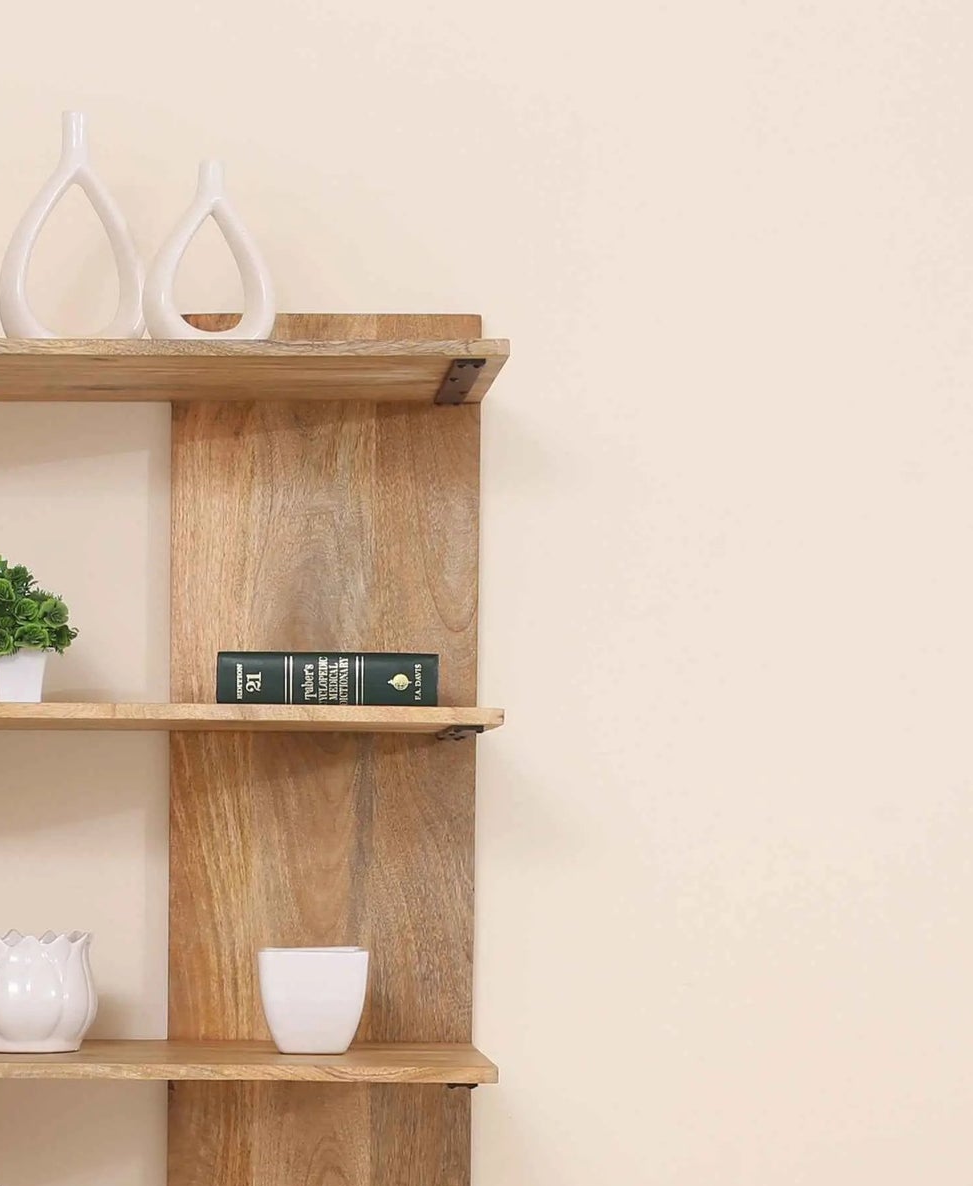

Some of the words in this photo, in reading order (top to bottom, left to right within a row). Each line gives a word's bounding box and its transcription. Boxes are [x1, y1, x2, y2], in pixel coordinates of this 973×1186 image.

[245, 671, 262, 693] 21
[303, 663, 317, 701] Taber's
[328, 662, 338, 701] MEDICAL
[414, 663, 422, 687] DAVIS
